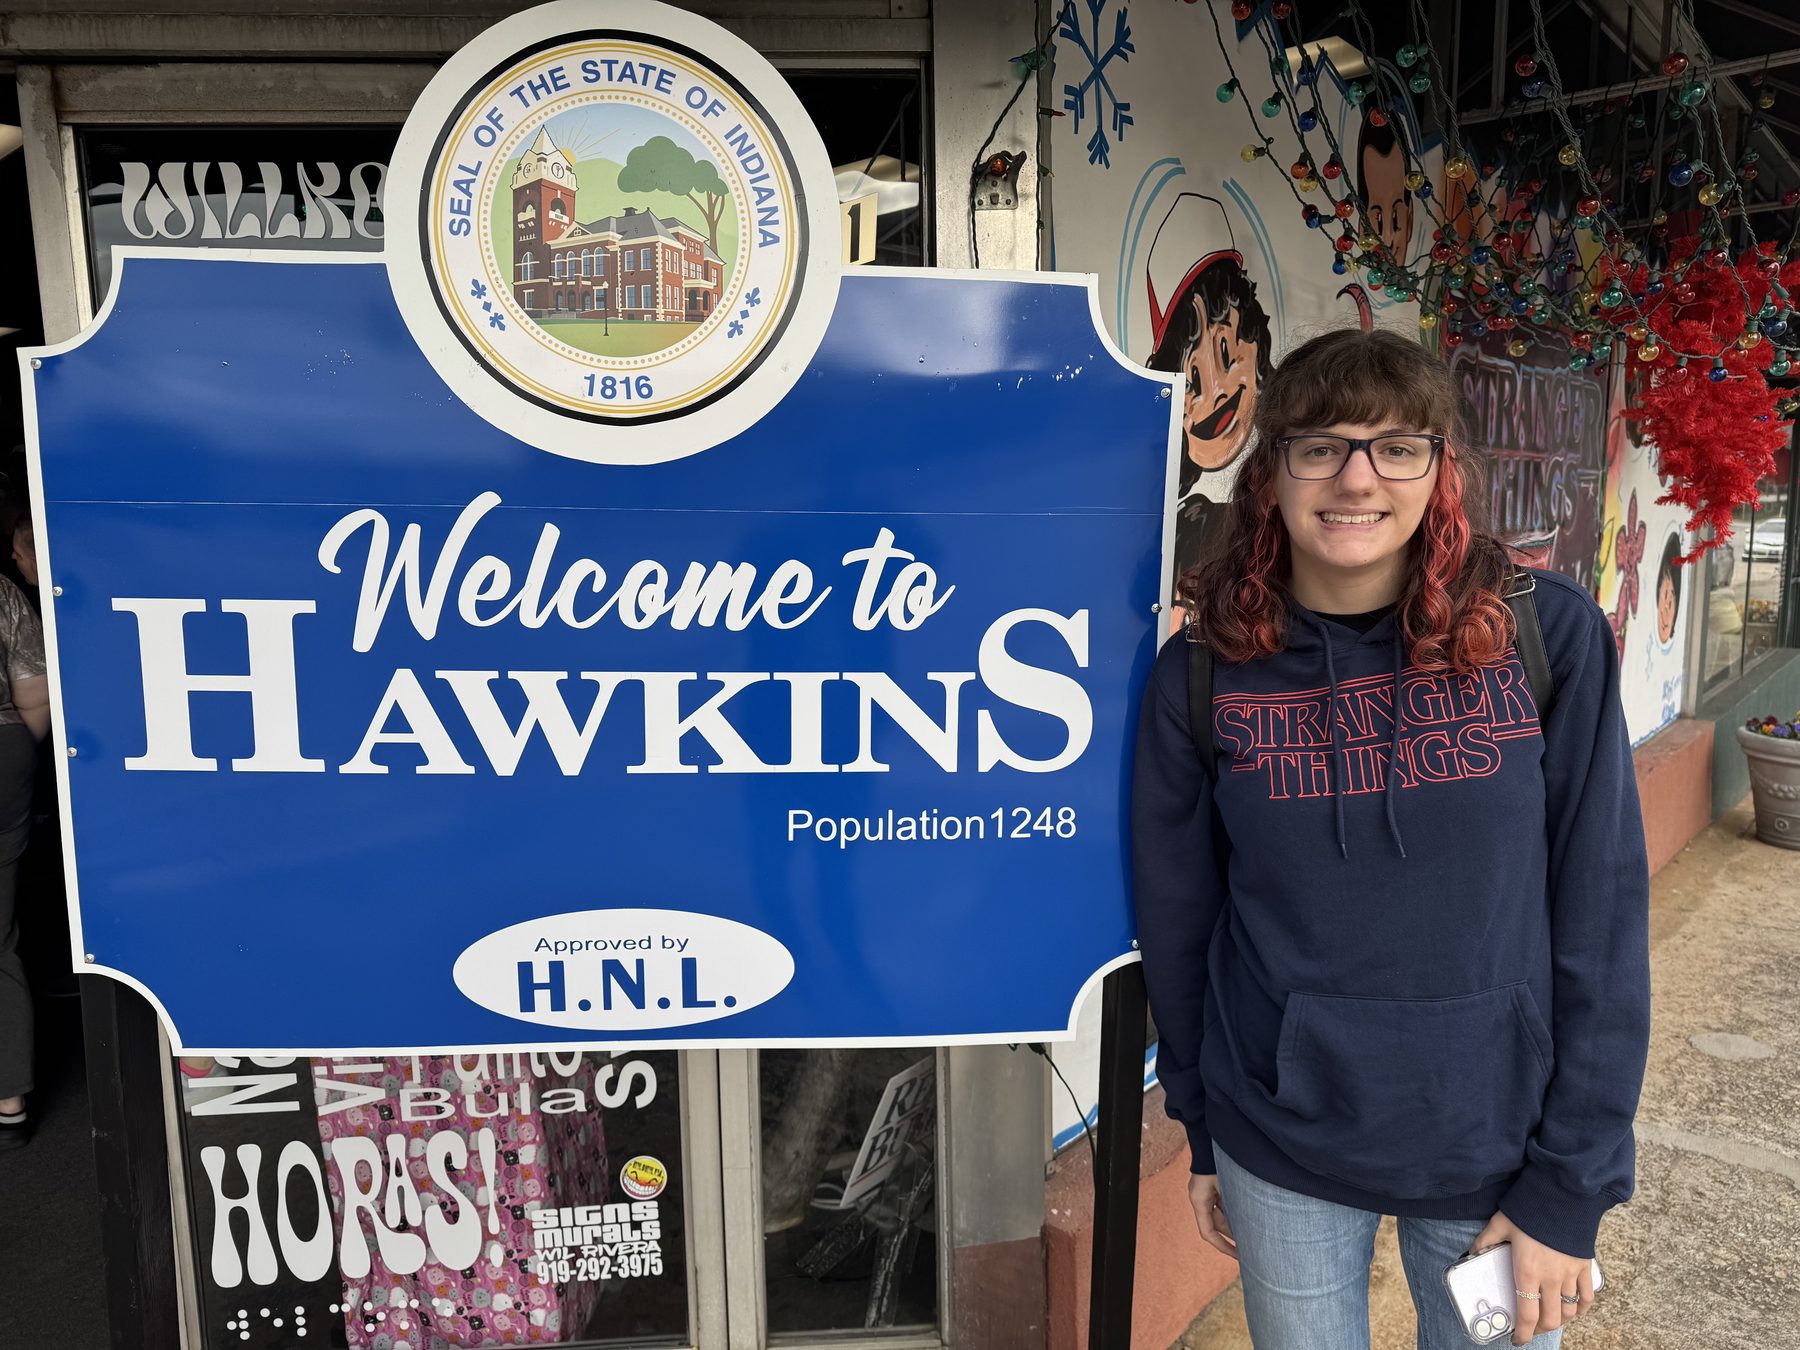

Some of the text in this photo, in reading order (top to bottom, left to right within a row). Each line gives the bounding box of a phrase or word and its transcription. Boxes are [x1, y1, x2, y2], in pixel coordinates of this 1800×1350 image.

[449, 59, 780, 249] SEAL OF THE STATE OF INDIANA
[583, 373, 654, 400] 1816
[318, 491, 956, 654] Welcome to
[111, 597, 1093, 777] HAWKINS
[1214, 659, 1539, 759] STRANGER
[1257, 723, 1502, 799] THINGS
[534, 935, 689, 955] Approved by
[517, 957, 737, 1013] H.N.L.
[400, 1083, 588, 1122] Bula
[200, 1127, 503, 1288] HORAS!
[535, 1240, 661, 1261] WIL RIVERA
[536, 1253, 663, 1285] 919-292-3975
